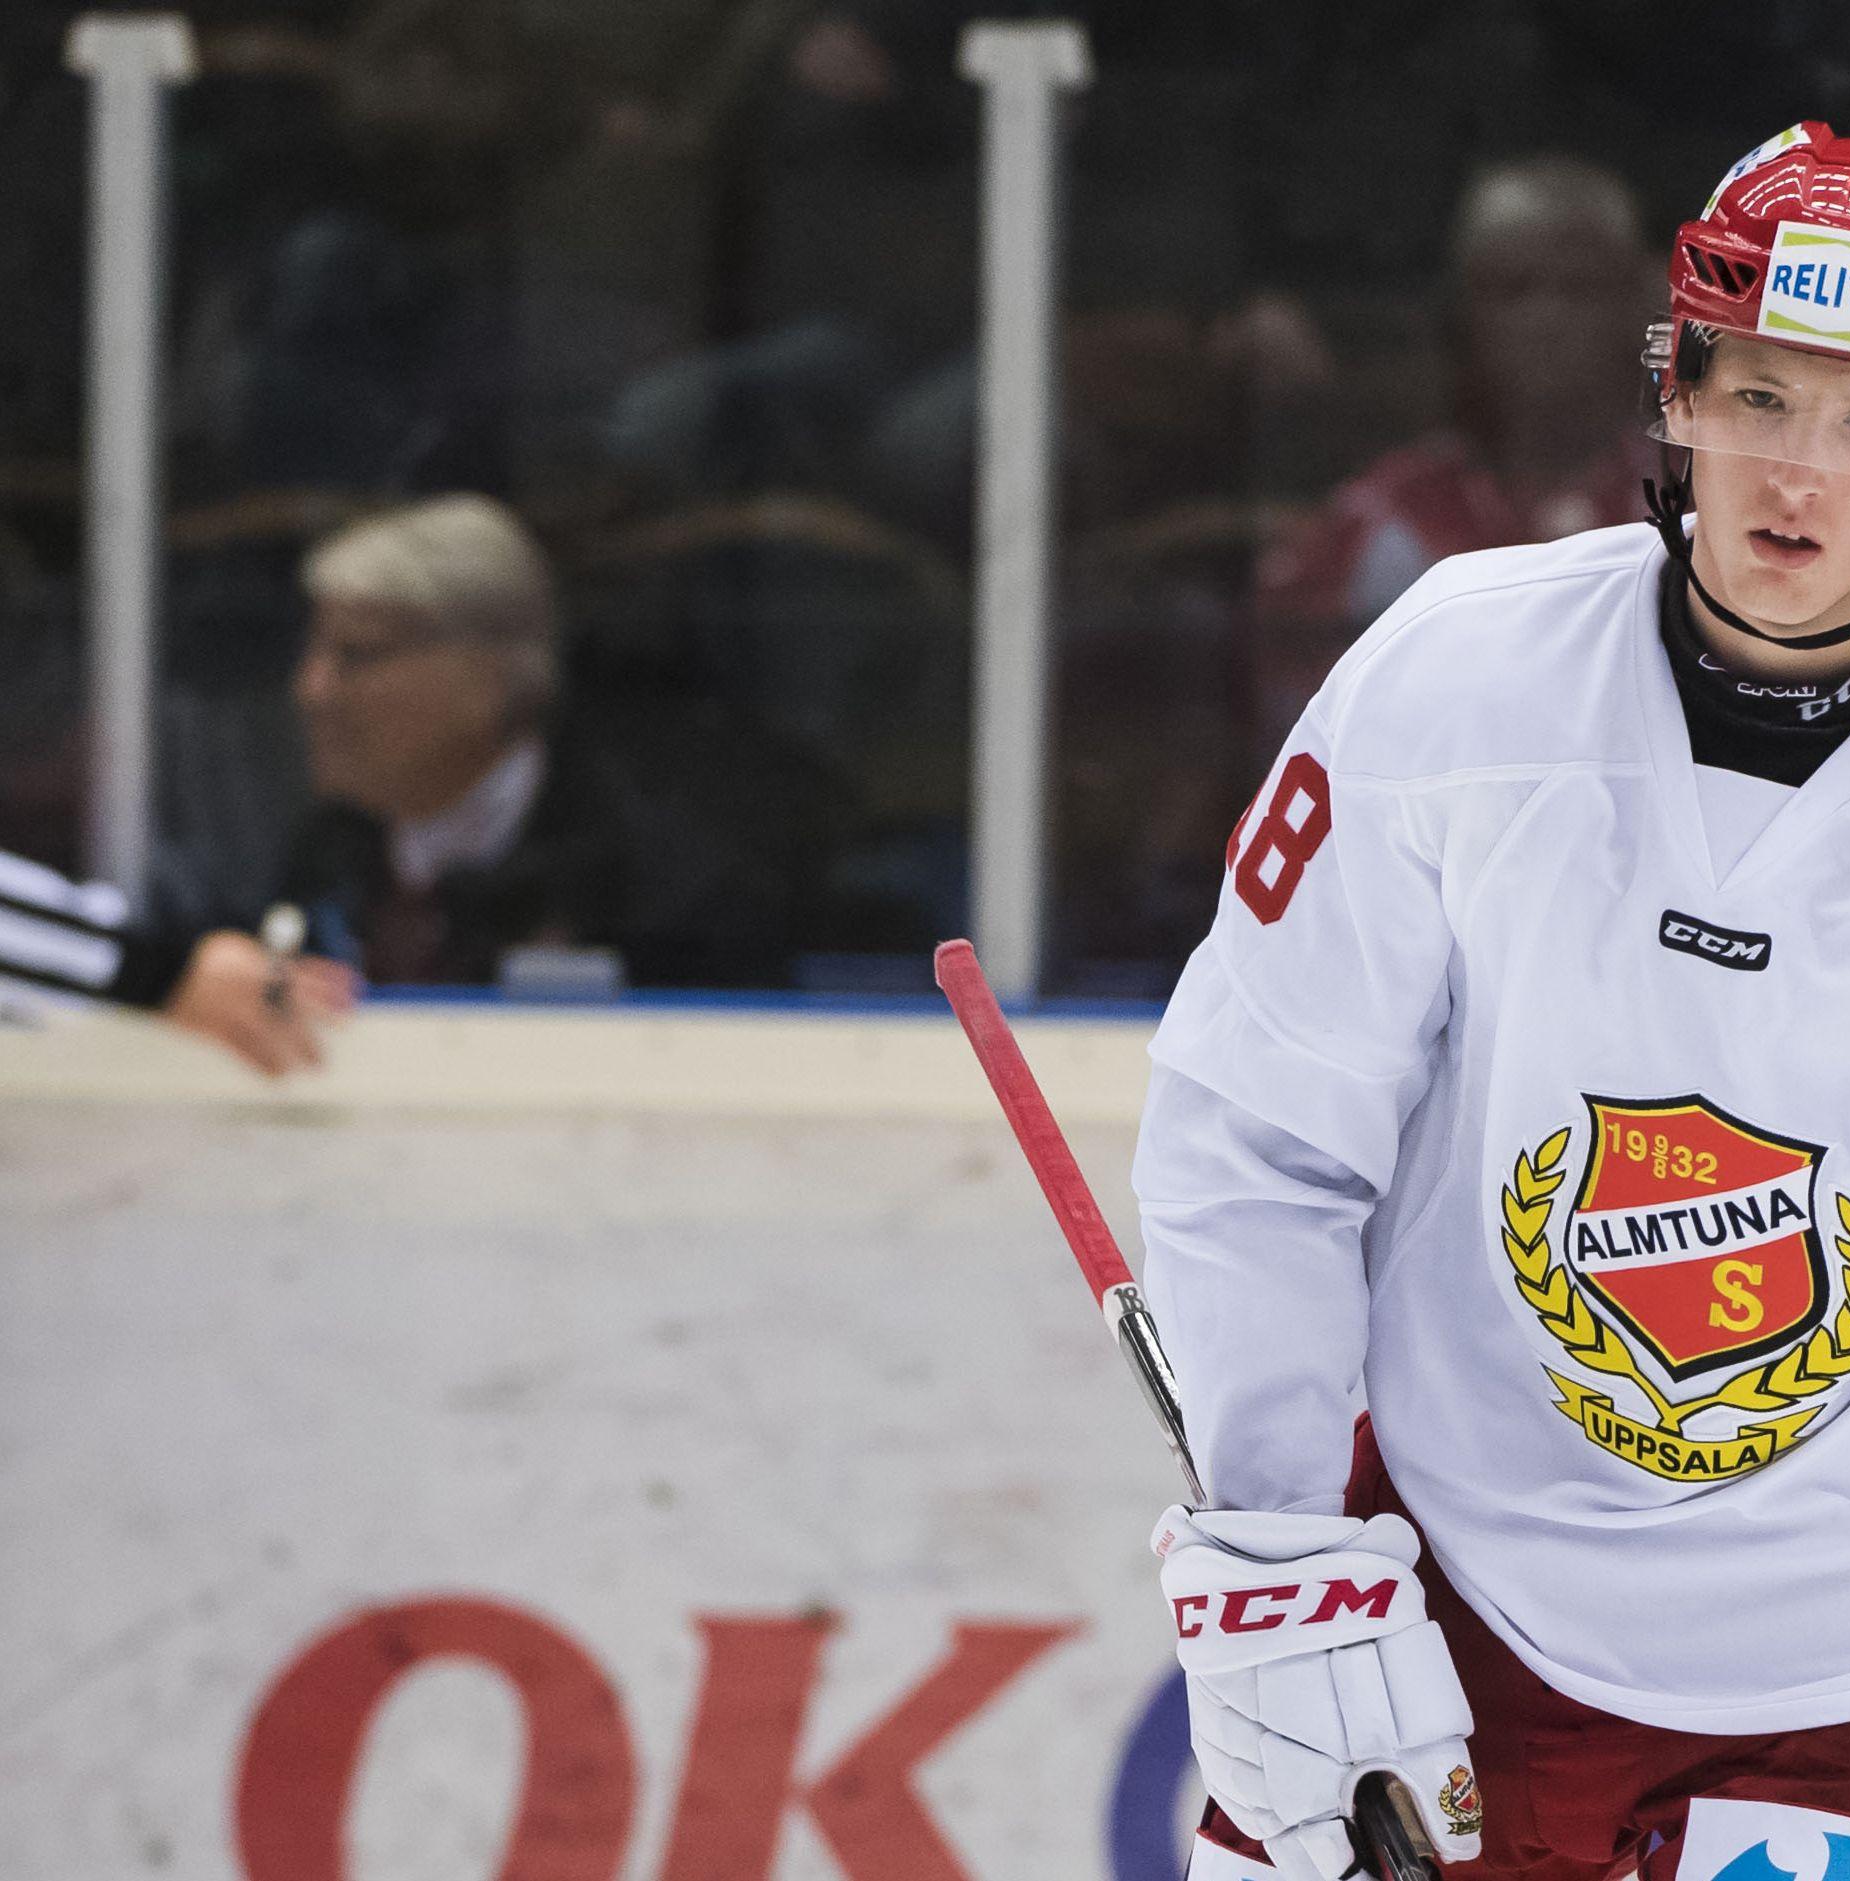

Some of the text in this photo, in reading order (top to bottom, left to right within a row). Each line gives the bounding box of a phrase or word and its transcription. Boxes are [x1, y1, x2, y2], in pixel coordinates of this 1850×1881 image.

[1225, 751, 1332, 926] 8
[1663, 919, 1766, 961] CCM
[1577, 1187, 1807, 1262] ALMTUNA
[1113, 1286, 1145, 1315] 18
[1590, 1411, 1761, 1475] UPPSALA
[1171, 1578, 1399, 1639] CCM
[232, 1592, 1212, 1881] OK
